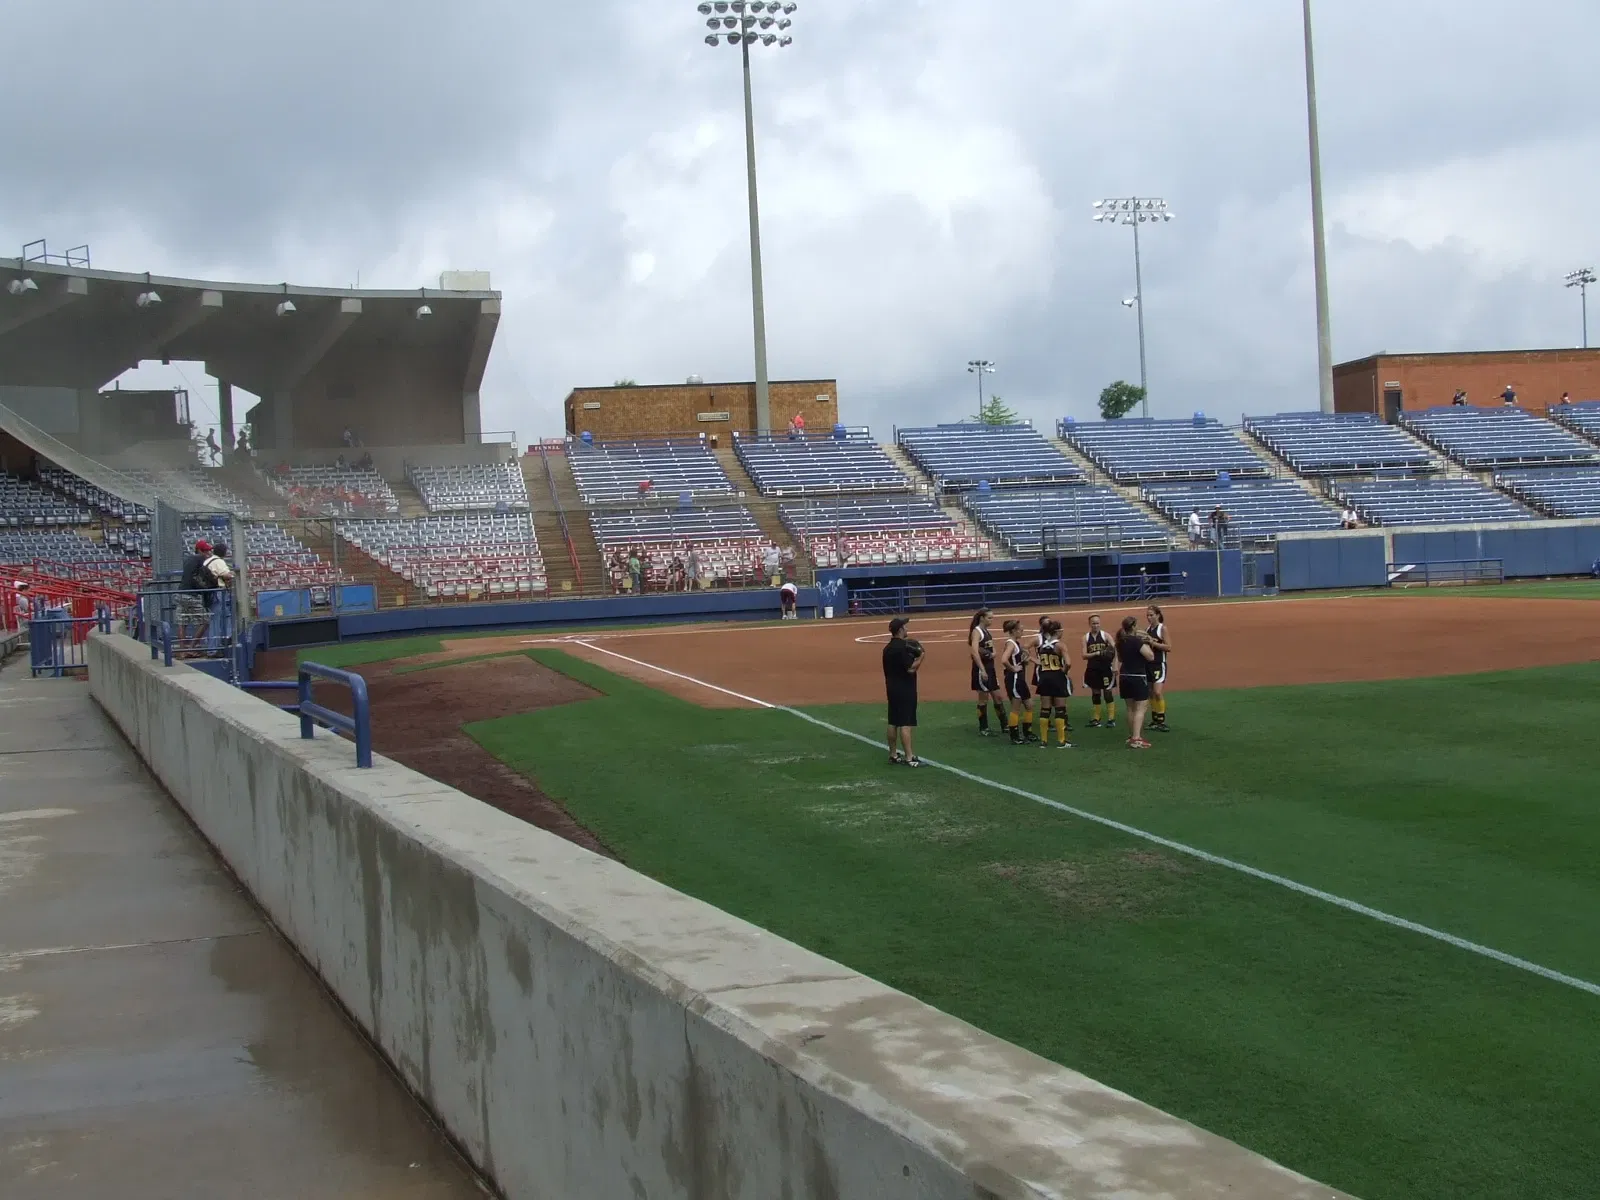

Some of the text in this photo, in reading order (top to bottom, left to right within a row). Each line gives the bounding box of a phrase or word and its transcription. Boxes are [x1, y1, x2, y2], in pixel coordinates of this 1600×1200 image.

[1040, 653, 1061, 671] 20
[1154, 671, 1160, 680] 7
[1103, 676, 1110, 686] 2
